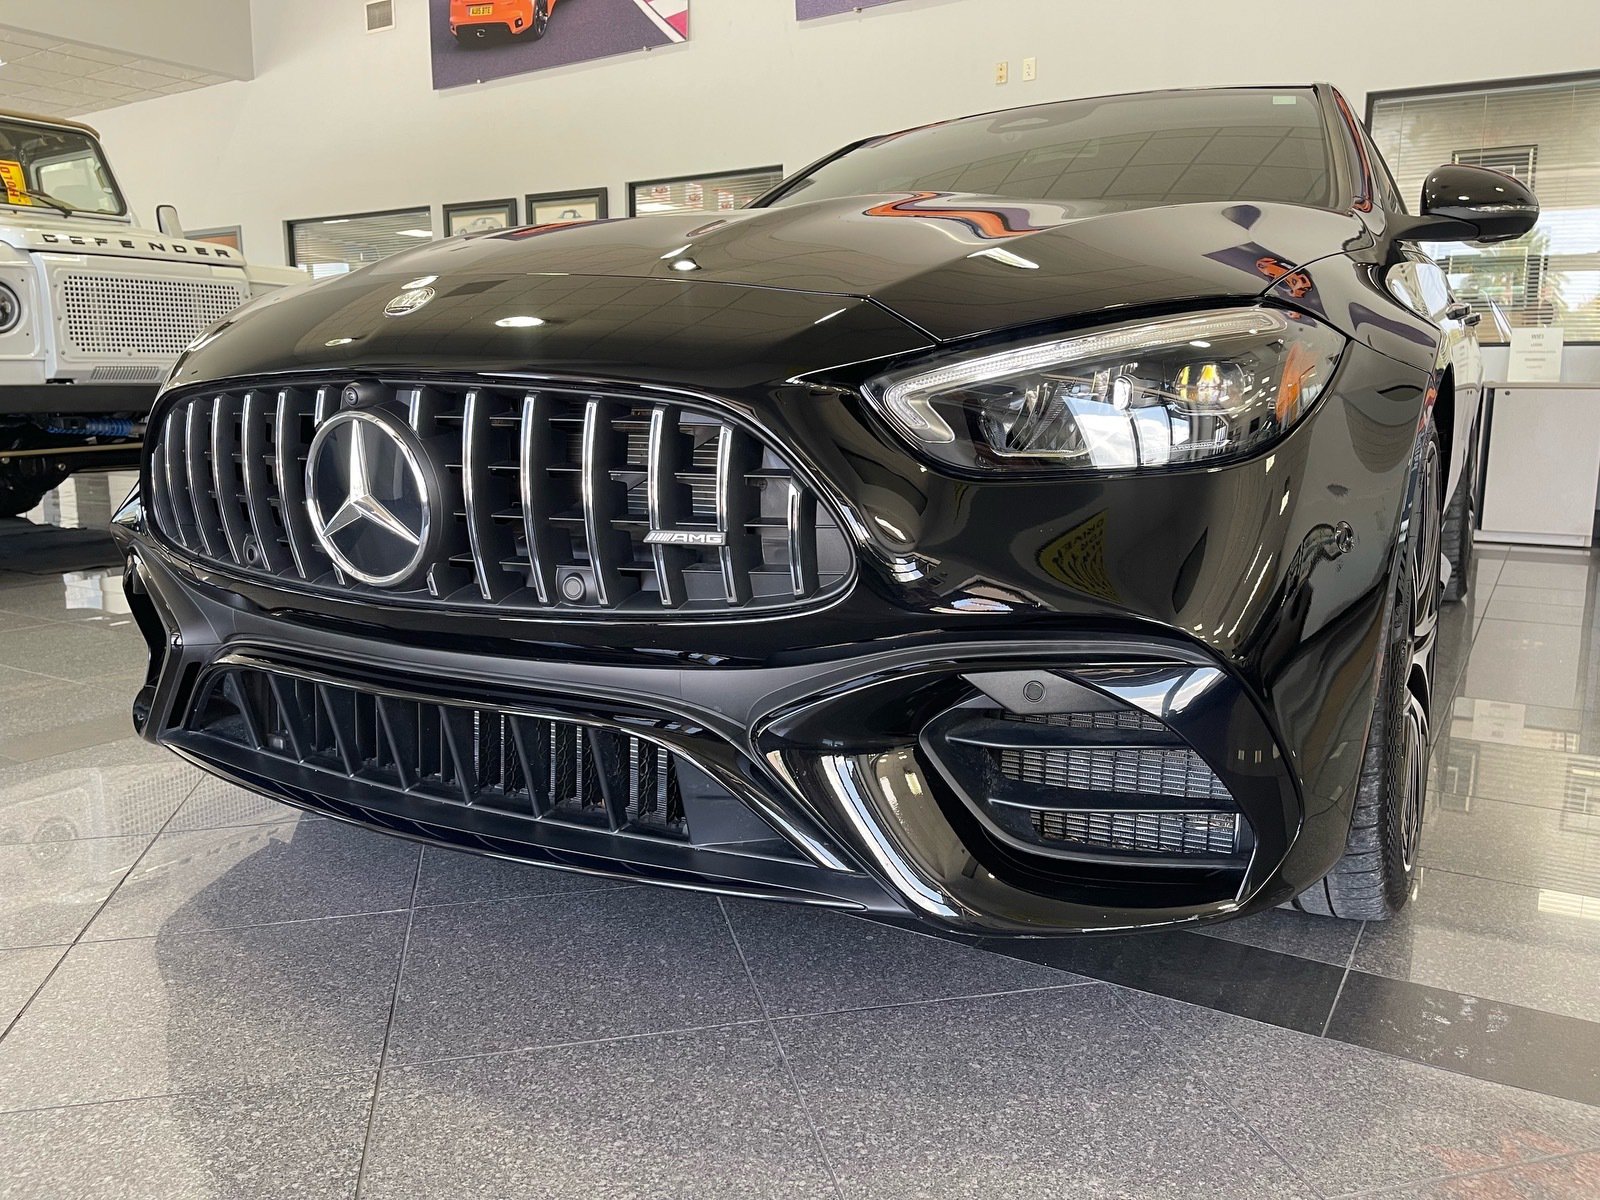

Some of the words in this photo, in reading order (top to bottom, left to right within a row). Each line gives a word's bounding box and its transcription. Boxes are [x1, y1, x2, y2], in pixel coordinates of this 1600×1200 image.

[0, 166, 20, 198] HOLD
[41, 233, 231, 258] DEFENDER
[670, 532, 723, 544] AMG
